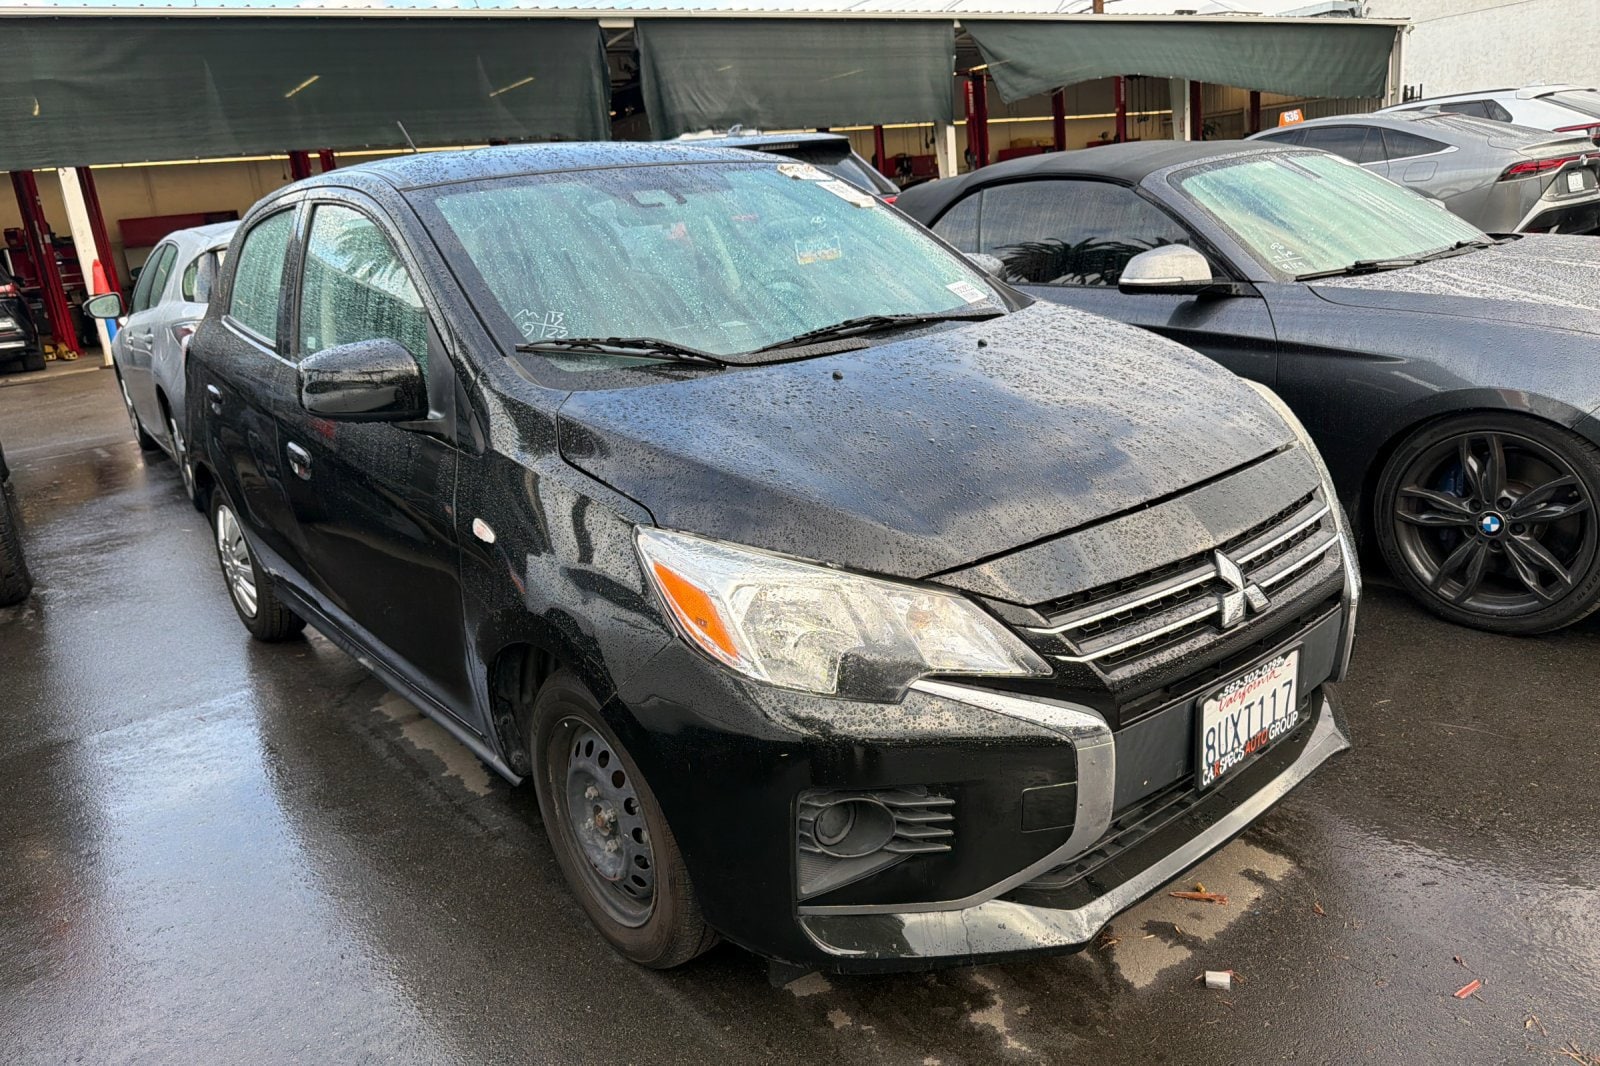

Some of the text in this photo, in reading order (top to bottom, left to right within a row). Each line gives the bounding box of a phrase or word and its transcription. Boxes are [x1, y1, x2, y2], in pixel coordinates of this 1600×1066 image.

[1205, 678, 1293, 768] 8UXT117
[1245, 728, 1269, 756] AUTO
[1268, 711, 1299, 740] GROUP
